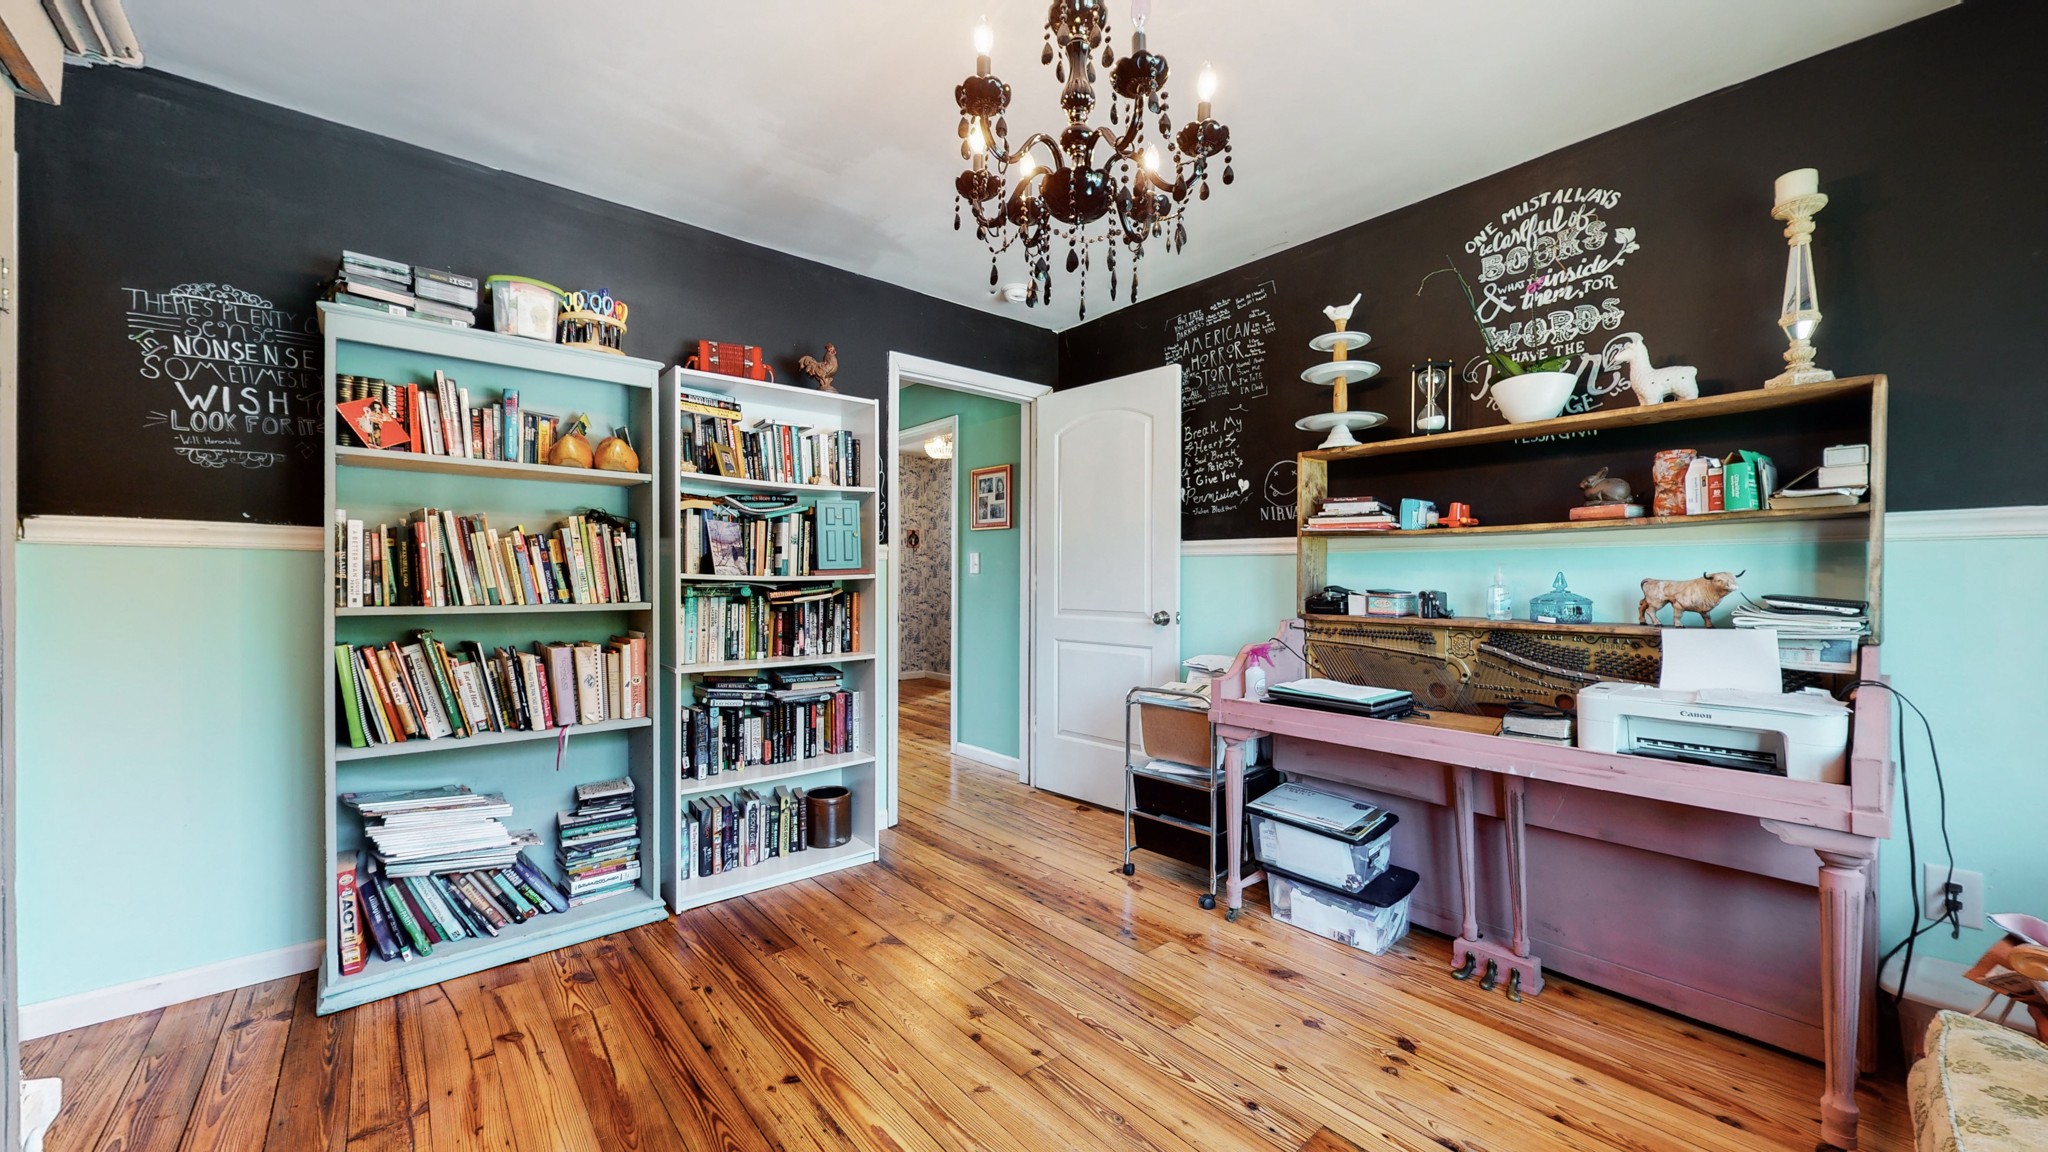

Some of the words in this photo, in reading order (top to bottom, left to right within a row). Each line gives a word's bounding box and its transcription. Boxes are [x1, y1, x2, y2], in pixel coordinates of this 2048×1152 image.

[1465, 222, 1498, 254] ONE
[1501, 192, 1550, 224] MUST
[1551, 187, 1622, 209] ALWAYS
[1568, 204, 1596, 231] of
[1478, 220, 1608, 283] BOOKS
[1583, 274, 1618, 294] FOR
[1474, 283, 1516, 323] &
[1497, 281, 1525, 294] WHAT
[222, 305, 296, 329] PLENTY
[1485, 298, 1625, 353] WORDS
[1176, 322, 1204, 342] DARKNESS
[1182, 321, 1250, 356] AMERICAN
[173, 335, 317, 370] NONSENSE
[1191, 341, 1244, 371] HORROR
[1510, 347, 1549, 363] HAVE
[1553, 341, 1585, 357] THE
[1190, 363, 1234, 389] STORY
[175, 382, 288, 415] WISH
[387, 386, 397, 419] COMPACT
[171, 409, 237, 432] LOOK
[246, 415, 294, 436] FOR
[1184, 421, 1218, 442] Break
[1224, 416, 1242, 432] My
[1186, 478, 1191, 488] I
[1196, 475, 1218, 486] Give
[1221, 470, 1236, 482] You
[1185, 487, 1240, 505] Permission
[545, 570, 553, 589] DISCOVER
[1480, 660, 1495, 668] TEN
[419, 671, 428, 687] CHAIR
[424, 686, 432, 697] JAM
[428, 696, 442, 723] COOKBOOK
[470, 693, 480, 708] Heal
[1494, 693, 1524, 701] FRAME
[1520, 688, 1550, 697] METAL
[1680, 710, 1712, 720] Canon
